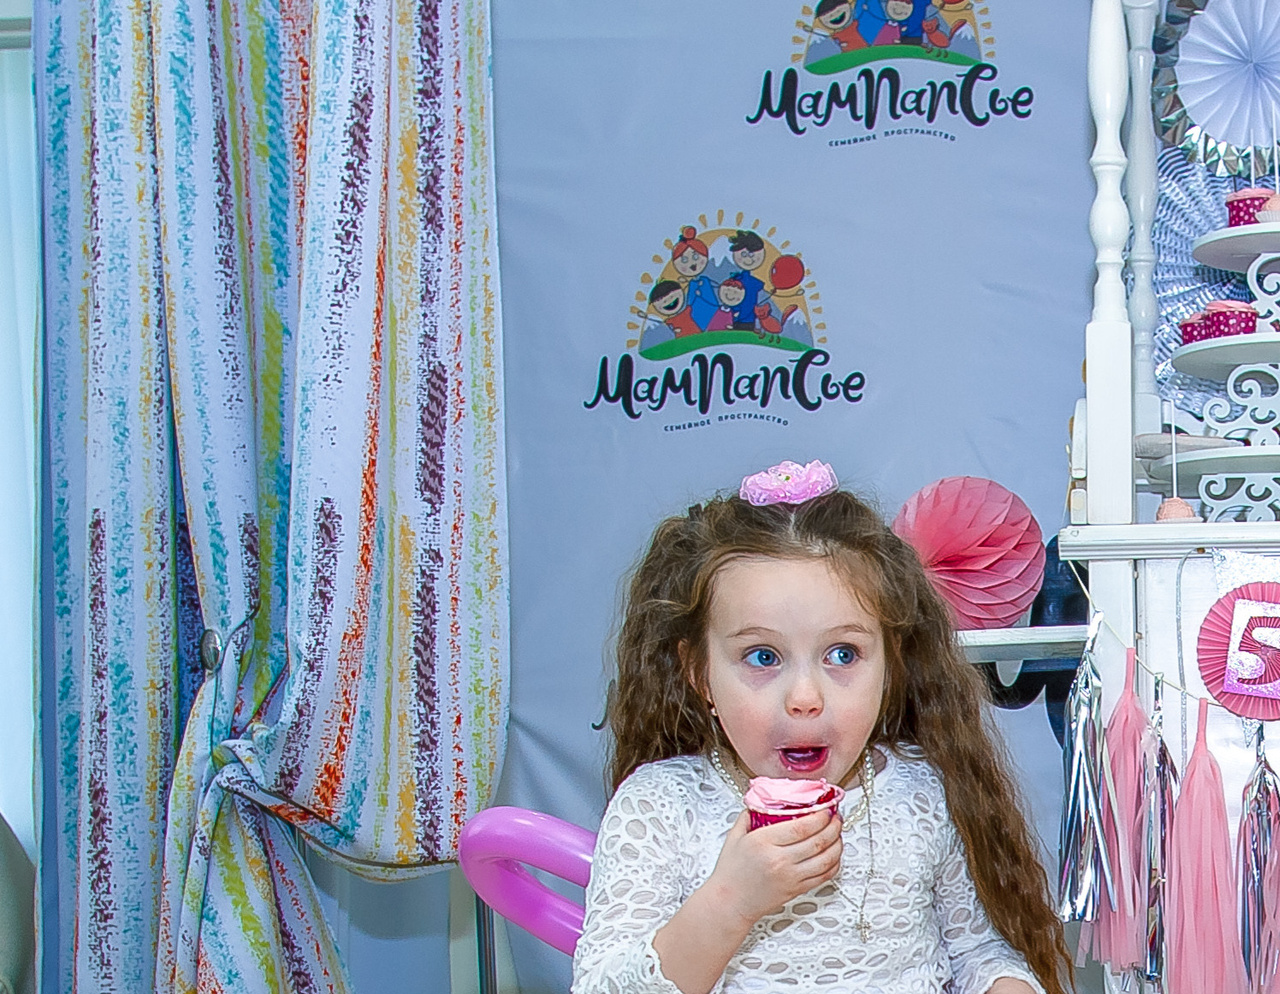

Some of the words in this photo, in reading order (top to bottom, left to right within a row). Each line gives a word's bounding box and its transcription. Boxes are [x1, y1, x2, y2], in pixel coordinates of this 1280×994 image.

[746, 62, 1034, 136] МамПапСье
[829, 133, 877, 147] СЕМЕЙНОЕ
[884, 127, 956, 142] ПРОСТРАНСТВО
[584, 348, 865, 419] МамПапСье
[664, 418, 711, 432] СЕМЕЙНОЕ
[718, 412, 789, 426] ПРОСТРАНСТВО
